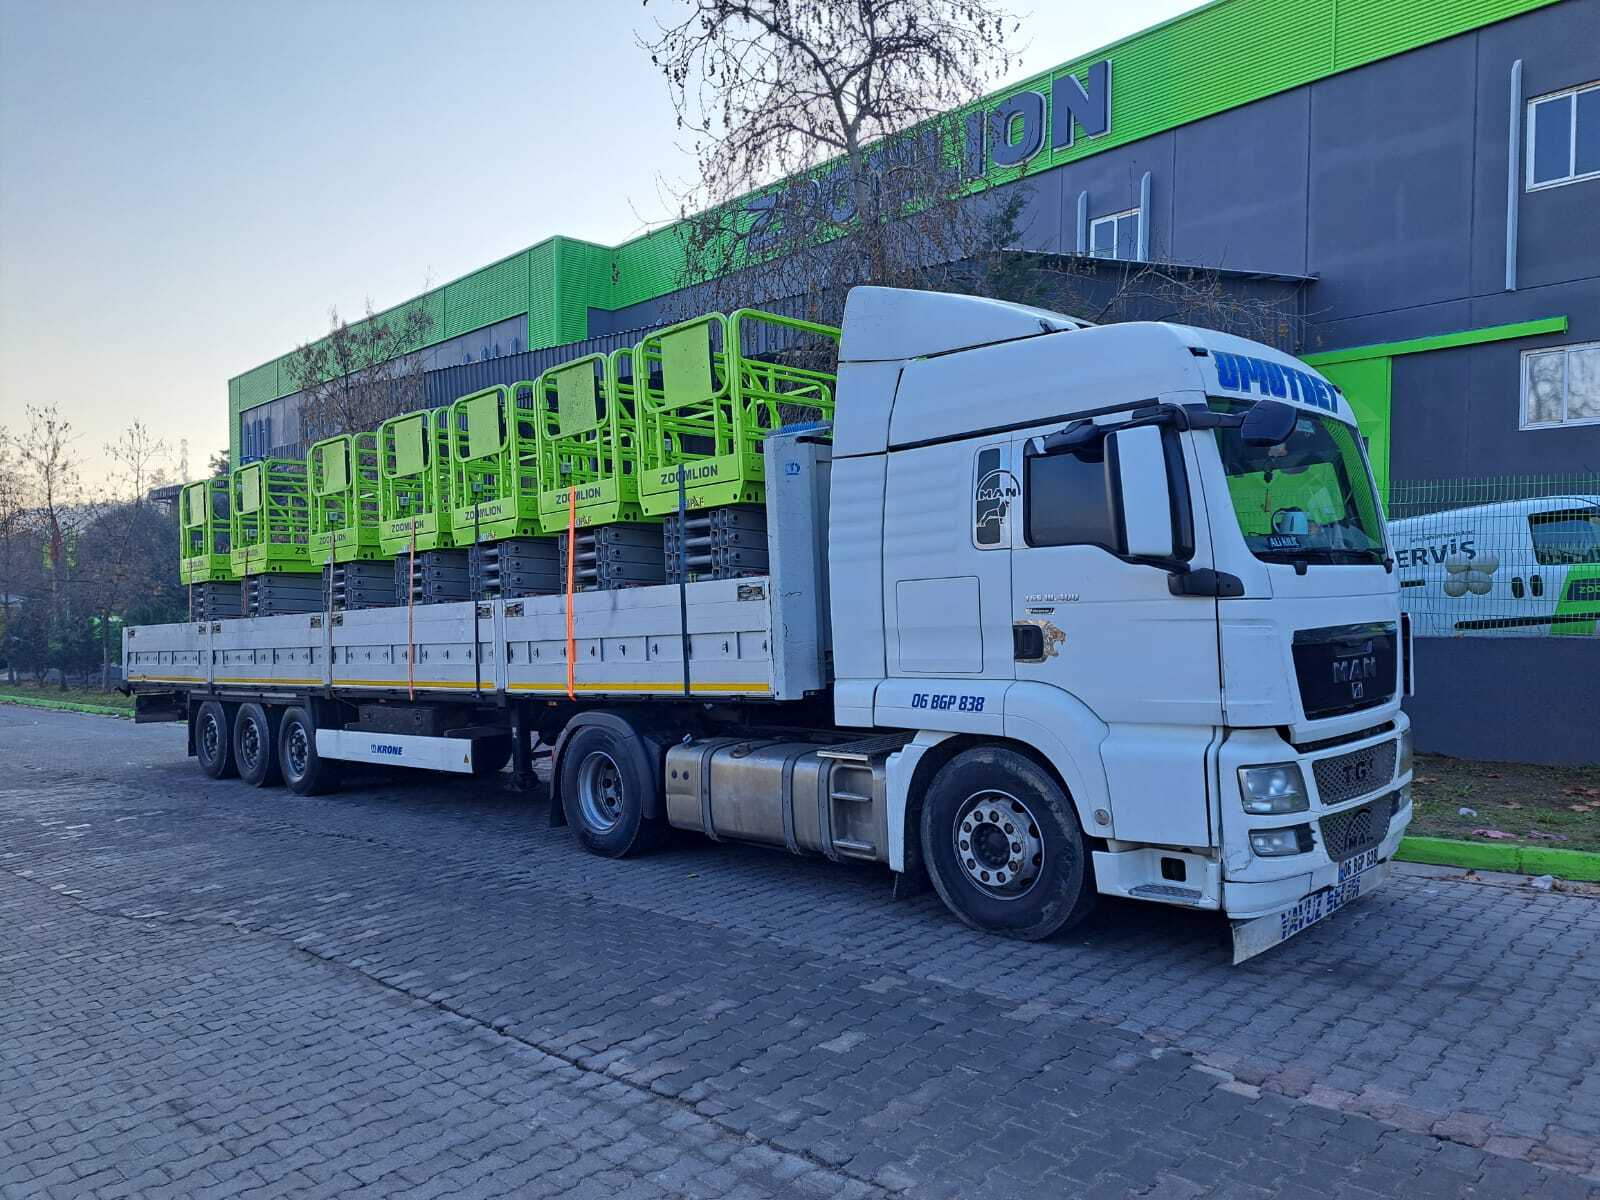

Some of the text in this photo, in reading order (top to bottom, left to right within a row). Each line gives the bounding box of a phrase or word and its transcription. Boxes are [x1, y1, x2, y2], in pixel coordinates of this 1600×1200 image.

[979, 487, 1017, 500] MAN
[464, 505, 502, 521] ZOMLION
[391, 519, 424, 533] ZOOMLON
[1333, 656, 1376, 683] MAN
[911, 693, 985, 712] 06 BGP 838
[377, 745, 403, 756] KRONE
